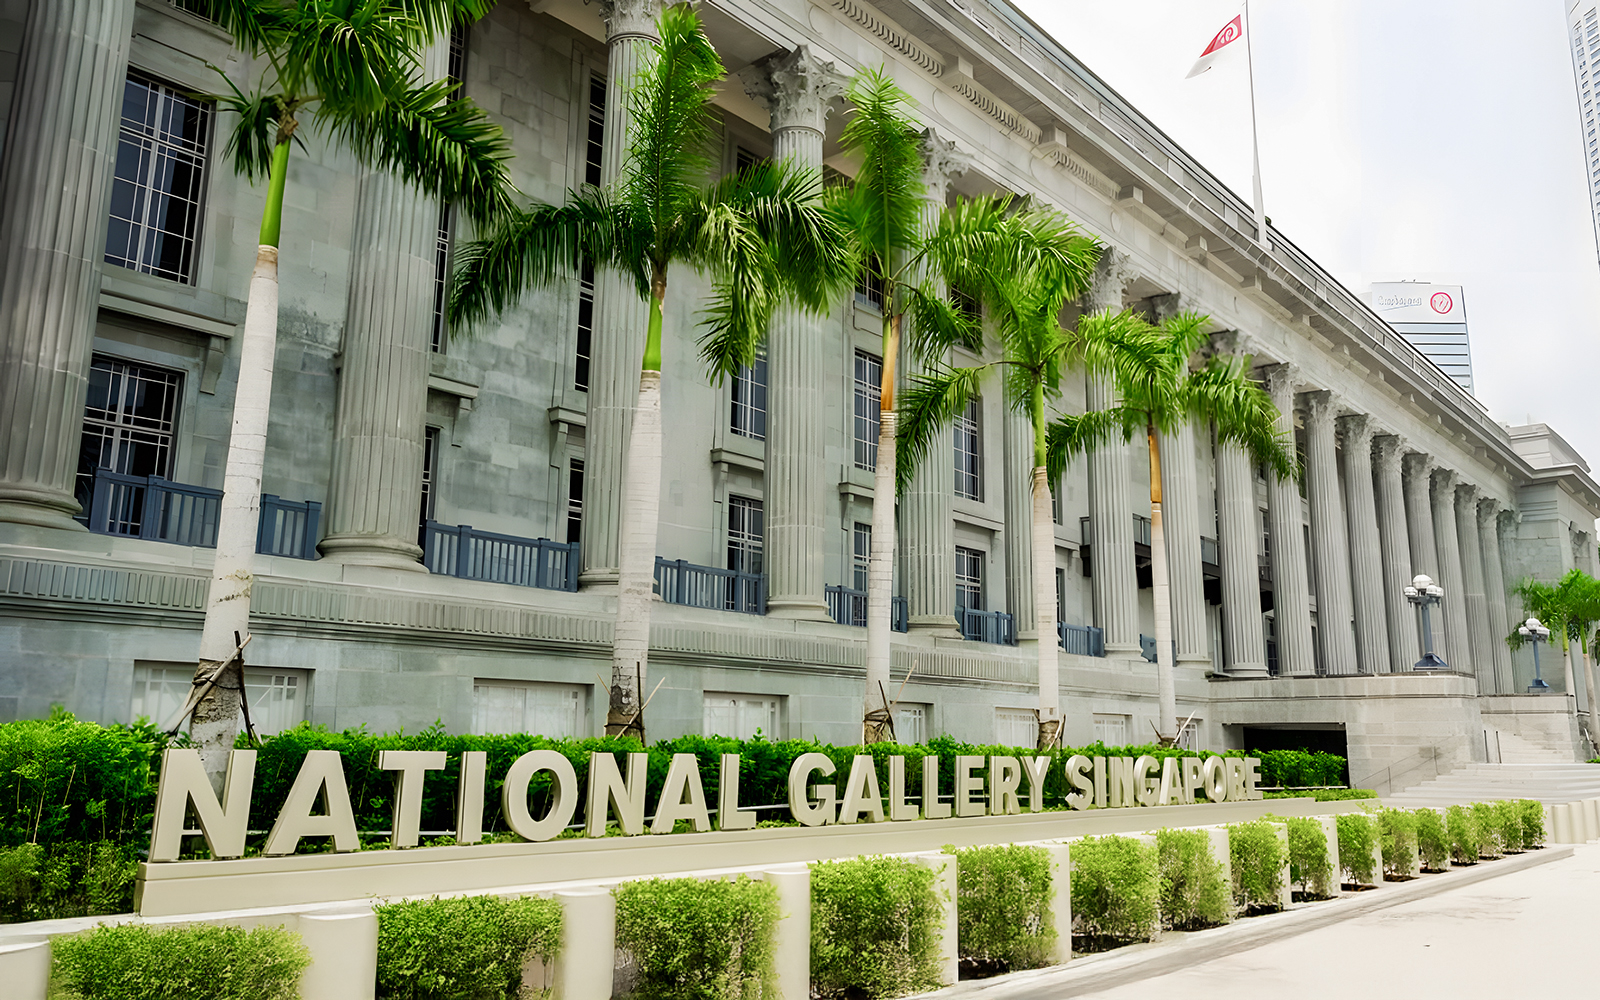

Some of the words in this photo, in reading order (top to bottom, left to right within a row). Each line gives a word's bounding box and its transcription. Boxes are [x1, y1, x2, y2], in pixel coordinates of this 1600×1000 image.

[150, 749, 757, 863] NATIONAL
[788, 752, 1051, 826] GALLERY
[1064, 755, 1263, 811] SINGAPORE
